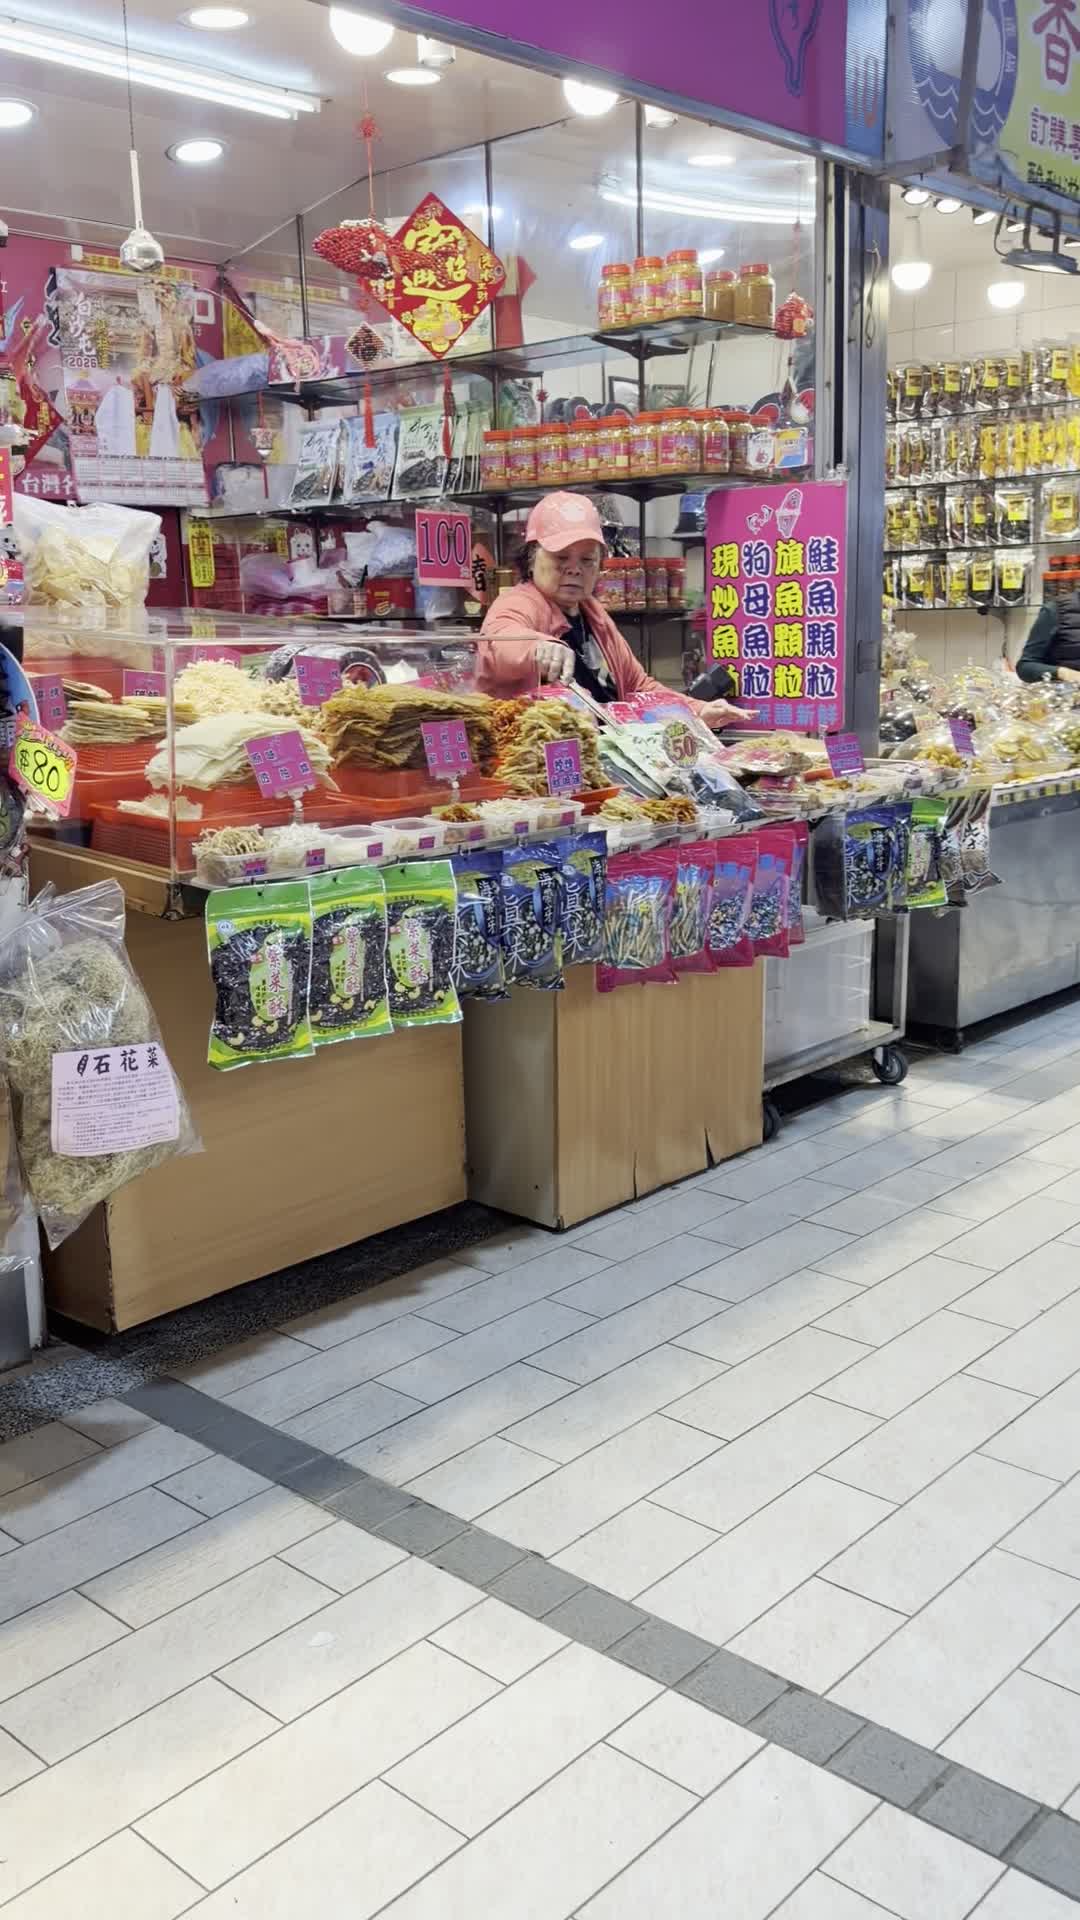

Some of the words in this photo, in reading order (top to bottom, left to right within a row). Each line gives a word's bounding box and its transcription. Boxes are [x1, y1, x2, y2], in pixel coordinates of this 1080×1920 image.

[68, 356, 97, 368] 2026
[421, 521, 467, 566] 100
[743, 541, 771, 697] 狗母魚粒
[774, 538, 805, 698] 旗魚顆粒
[807, 537, 838, 698] 鮭魚顆粒
[20, 749, 60, 792] $80
[672, 735, 693, 761] 50
[266, 944, 287, 1018] 紫菜酥
